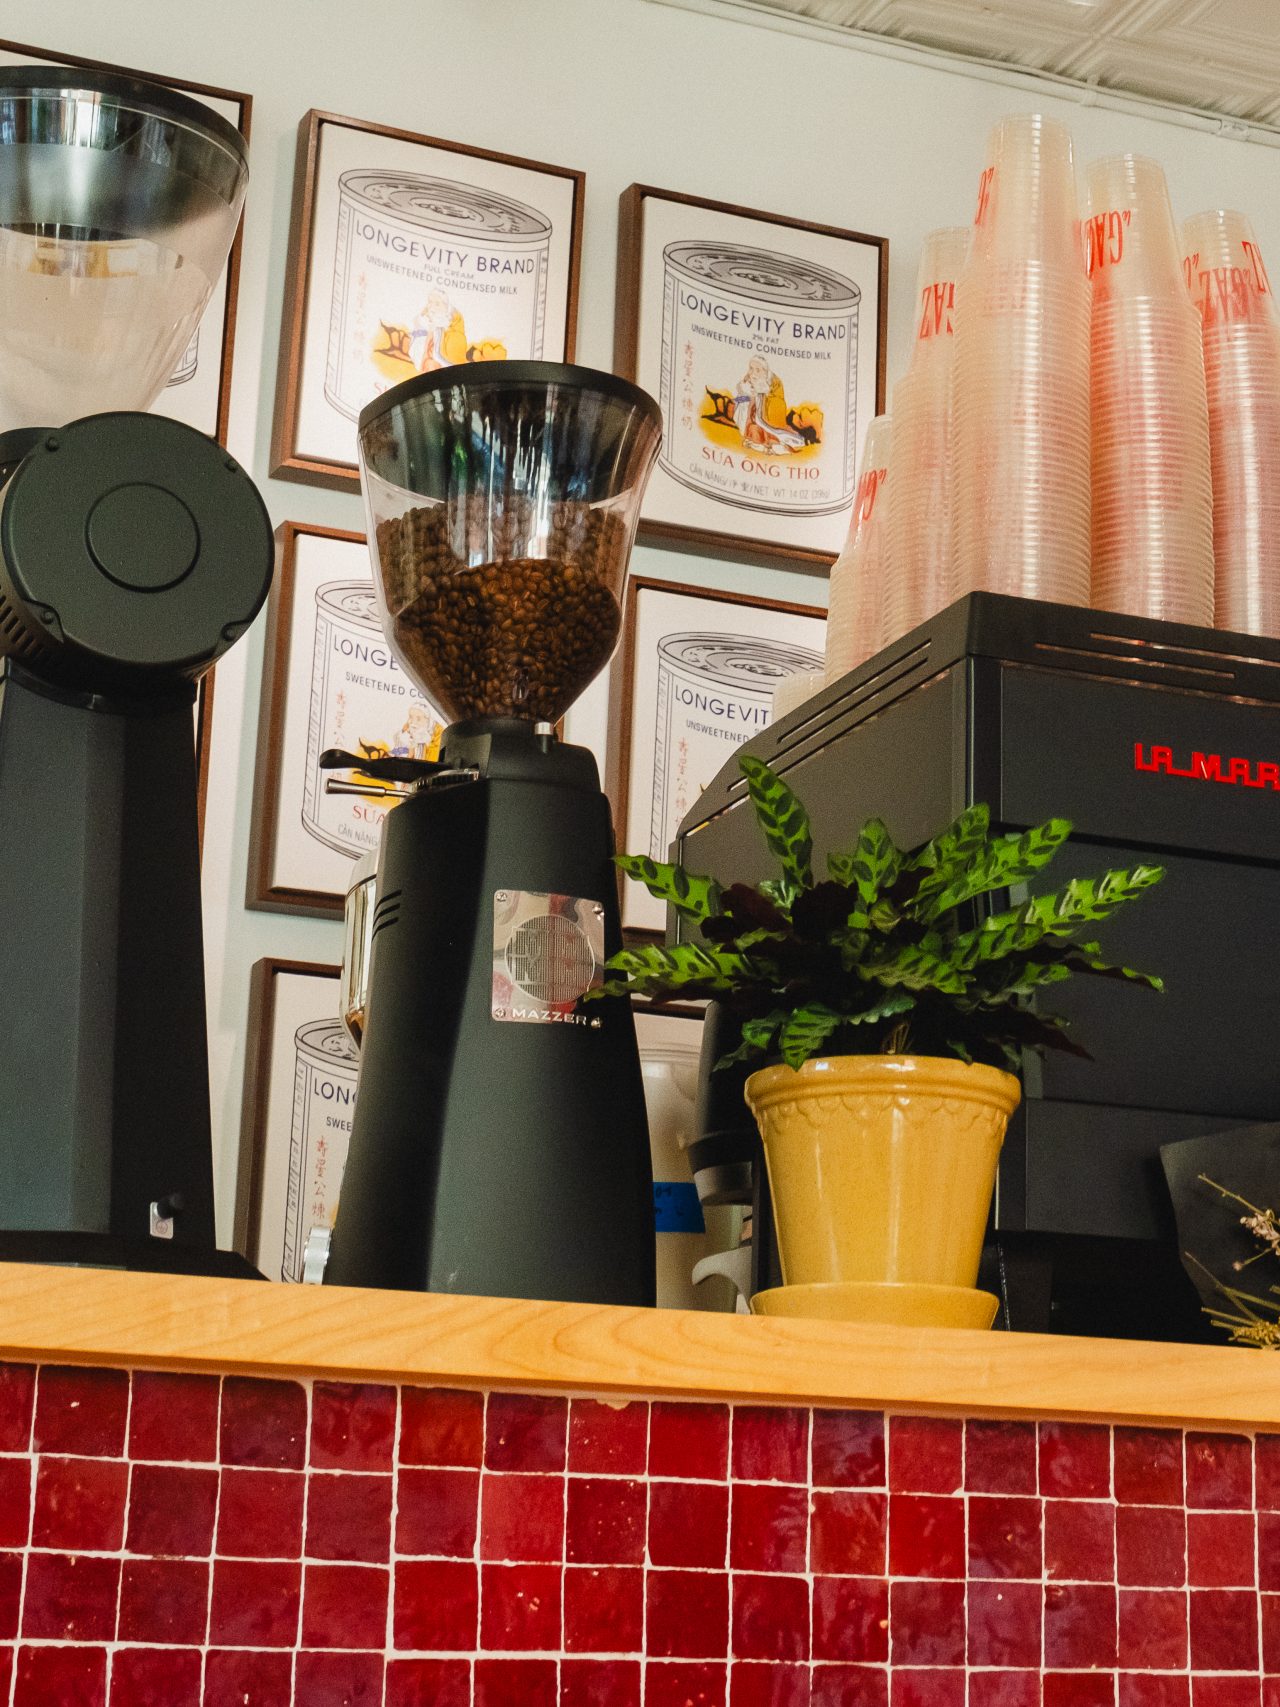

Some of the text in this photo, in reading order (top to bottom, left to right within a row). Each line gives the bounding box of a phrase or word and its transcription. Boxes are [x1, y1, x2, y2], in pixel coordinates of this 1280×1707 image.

[355, 219, 535, 274] LONGEVITY BRAND
[366, 254, 518, 295] UNSWEETENED CONDENSED MILK
[444, 267, 475, 280] CREAM
[680, 289, 846, 340] LONGEVITY BRAND
[691, 323, 831, 360] UNSWEETENED CONDENSED MILK
[766, 336, 779, 344] FAT
[346, 671, 406, 696] SWEETENED
[675, 684, 770, 725] LONGEVIT
[686, 719, 750, 743] UNSWEETENED
[1134, 743, 1173, 773] LA
[512, 1008, 587, 1026] MAZZER
